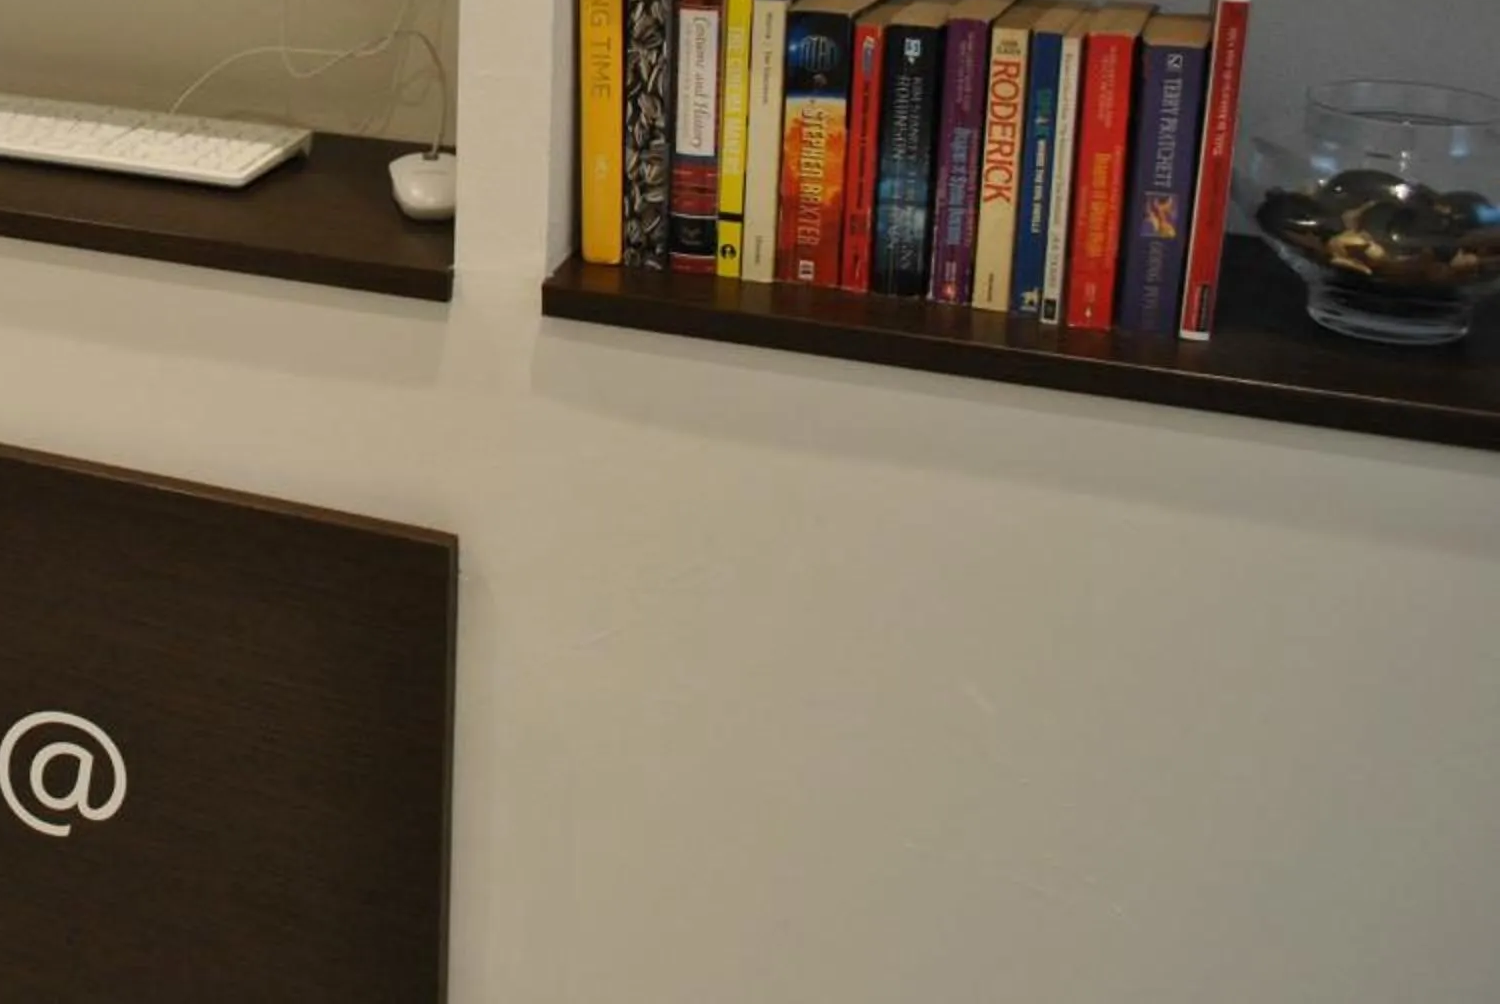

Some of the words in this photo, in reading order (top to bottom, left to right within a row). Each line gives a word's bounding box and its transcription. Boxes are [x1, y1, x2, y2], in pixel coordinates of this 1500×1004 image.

[589, 37, 612, 98] TIME
[694, 74, 709, 98] and
[1159, 78, 1183, 116] TERRY
[691, 102, 711, 149] History
[799, 107, 830, 179] STEPHEN
[892, 74, 911, 160] ROBINSON
[983, 60, 1021, 203] RODERICK
[1153, 117, 1179, 189] PRATCHETT
[797, 183, 822, 246] BAXTER
